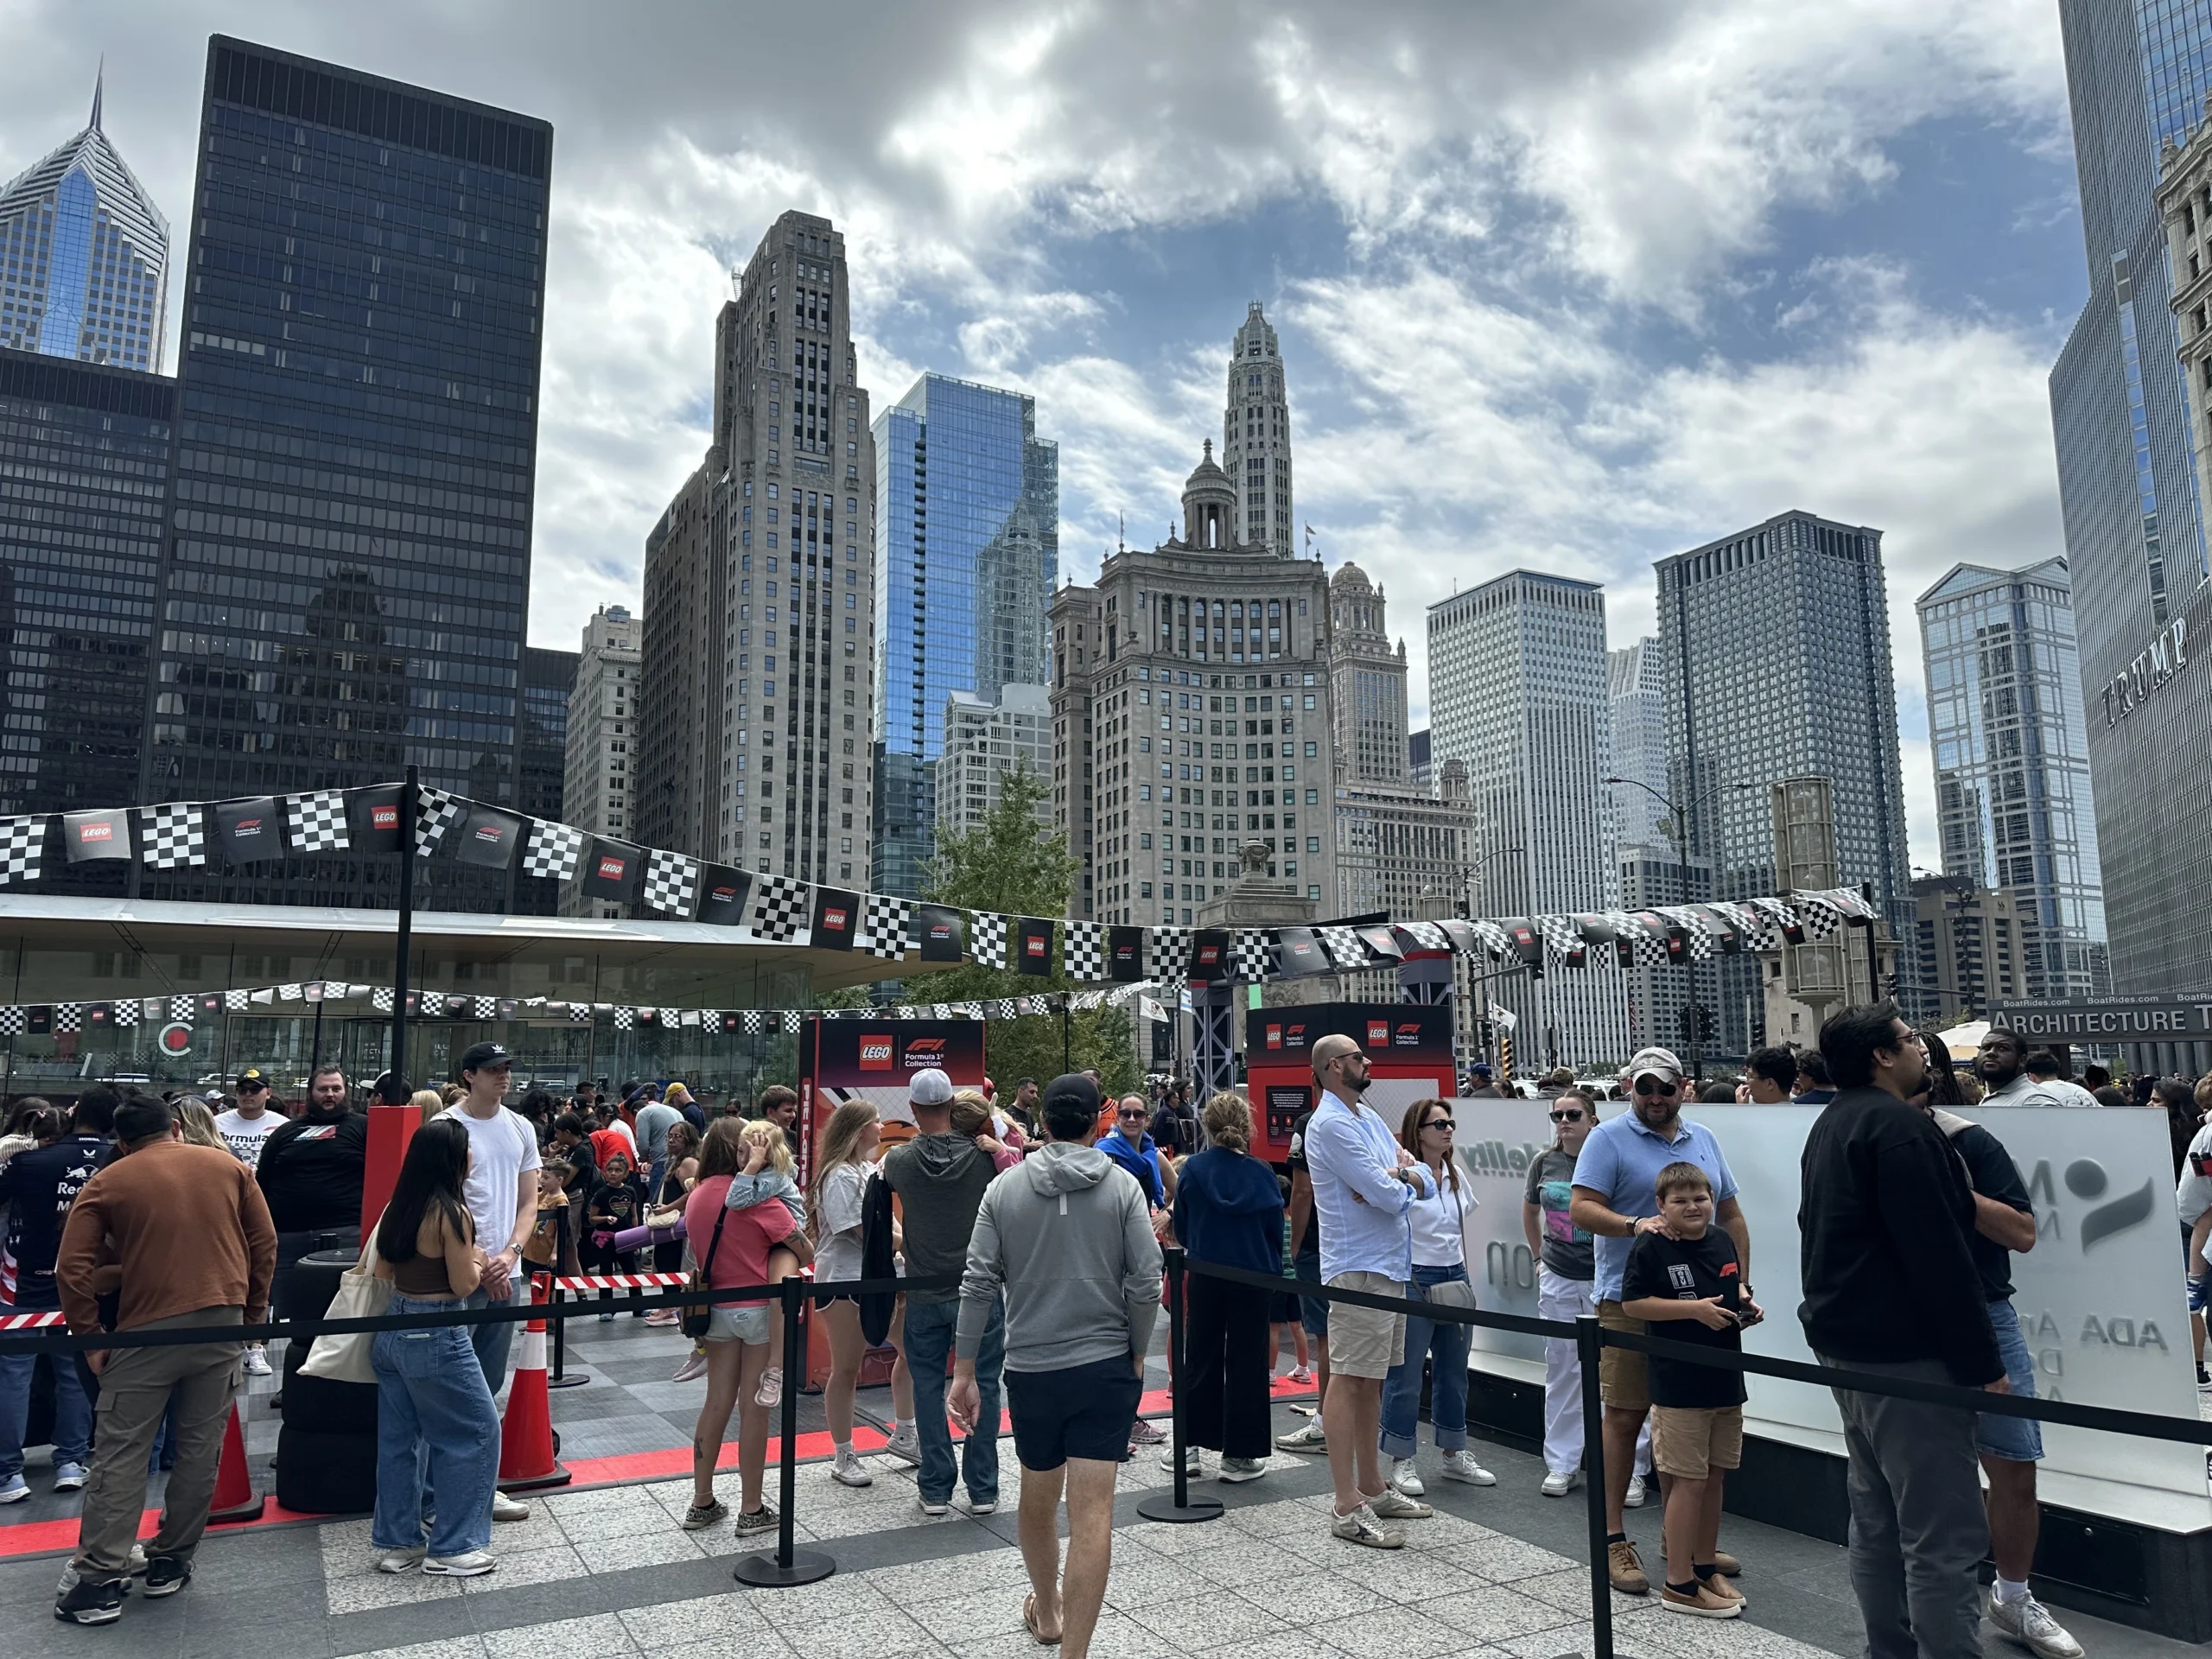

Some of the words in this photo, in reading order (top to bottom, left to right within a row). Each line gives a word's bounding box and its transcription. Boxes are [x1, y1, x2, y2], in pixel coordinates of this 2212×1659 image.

[2101, 618, 2187, 728] TRUMP
[374, 812, 397, 823] LEGO
[82, 827, 111, 837] LEGO
[600, 863, 623, 874] LEGO
[825, 914, 845, 924] LEGO
[1028, 941, 1044, 950] LEGO
[2003, 998, 2070, 1007] BoatRides.com
[2087, 995, 2159, 1004] BoatRides.com
[1993, 1010, 2186, 1034] ARCHITECTURE
[1268, 1031, 1281, 1041] LEGO
[1369, 1028, 1387, 1038] LEGO
[861, 1045, 892, 1060] LEGO
[219, 1132, 269, 1143] ormula
